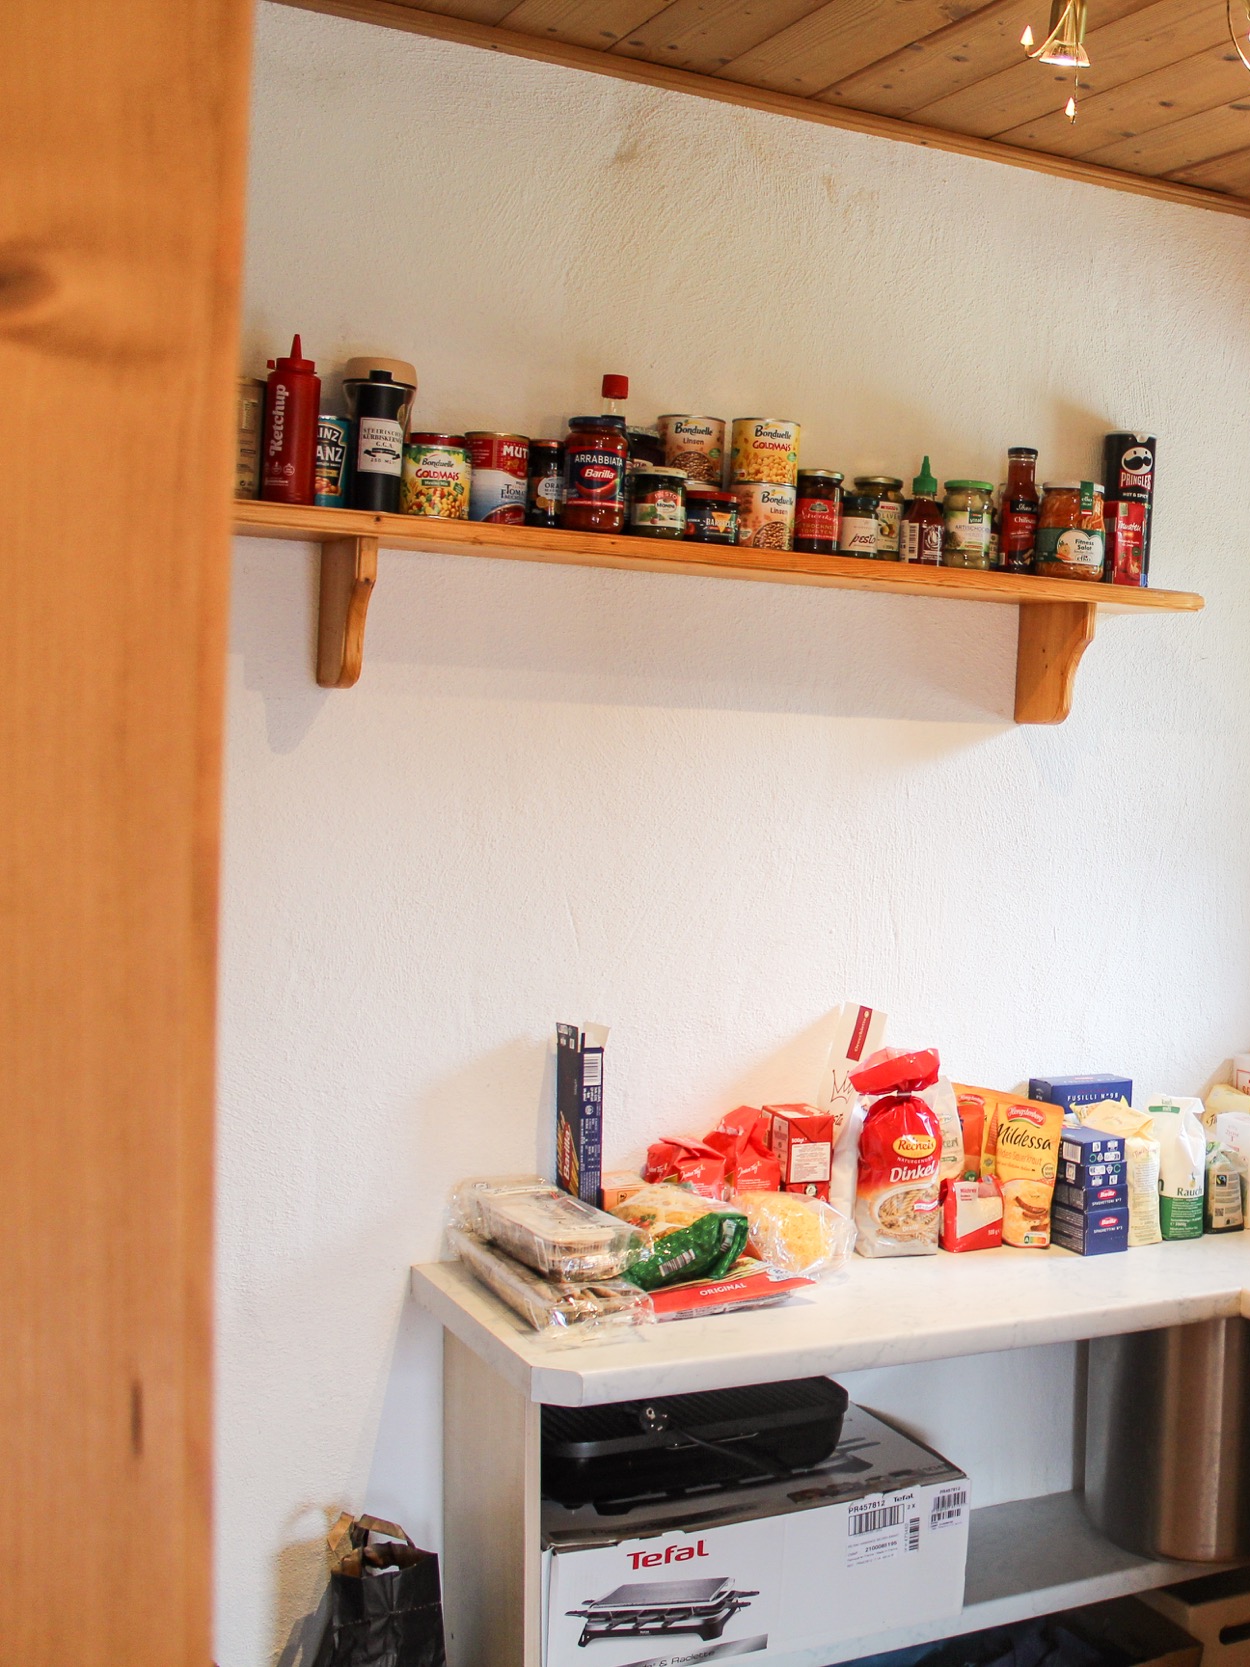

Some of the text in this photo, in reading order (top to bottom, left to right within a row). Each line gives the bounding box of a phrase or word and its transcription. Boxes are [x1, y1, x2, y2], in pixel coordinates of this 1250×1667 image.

[269, 384, 290, 457] Ketchup
[317, 426, 340, 442] INZ
[675, 421, 713, 437] Bonduelle
[754, 424, 792, 440] Bonduelle
[682, 437, 705, 446] Linsen
[316, 445, 343, 462] ANZ
[574, 454, 623, 467] ARRABBIATA
[421, 457, 455, 469] Bonduelle
[584, 468, 616, 479] Barilla
[1120, 471, 1152, 490] PRINGLES
[761, 490, 795, 506] Bonduelle
[769, 507, 789, 515] Linsen
[849, 533, 877, 547] pesto
[1067, 1094, 1097, 1102] FUSILLI
[997, 1123, 1052, 1151] Mildessa
[563, 1130, 571, 1181] Barilla
[889, 1160, 936, 1183] Dinkel
[1177, 1187, 1203, 1197] Rauch
[699, 1283, 747, 1297] ORIGINAL
[893, 1493, 914, 1503] Tefal
[848, 1500, 886, 1514] PR457812
[626, 1538, 709, 1571] Tefal
[671, 1650, 716, 1665] Raclette
